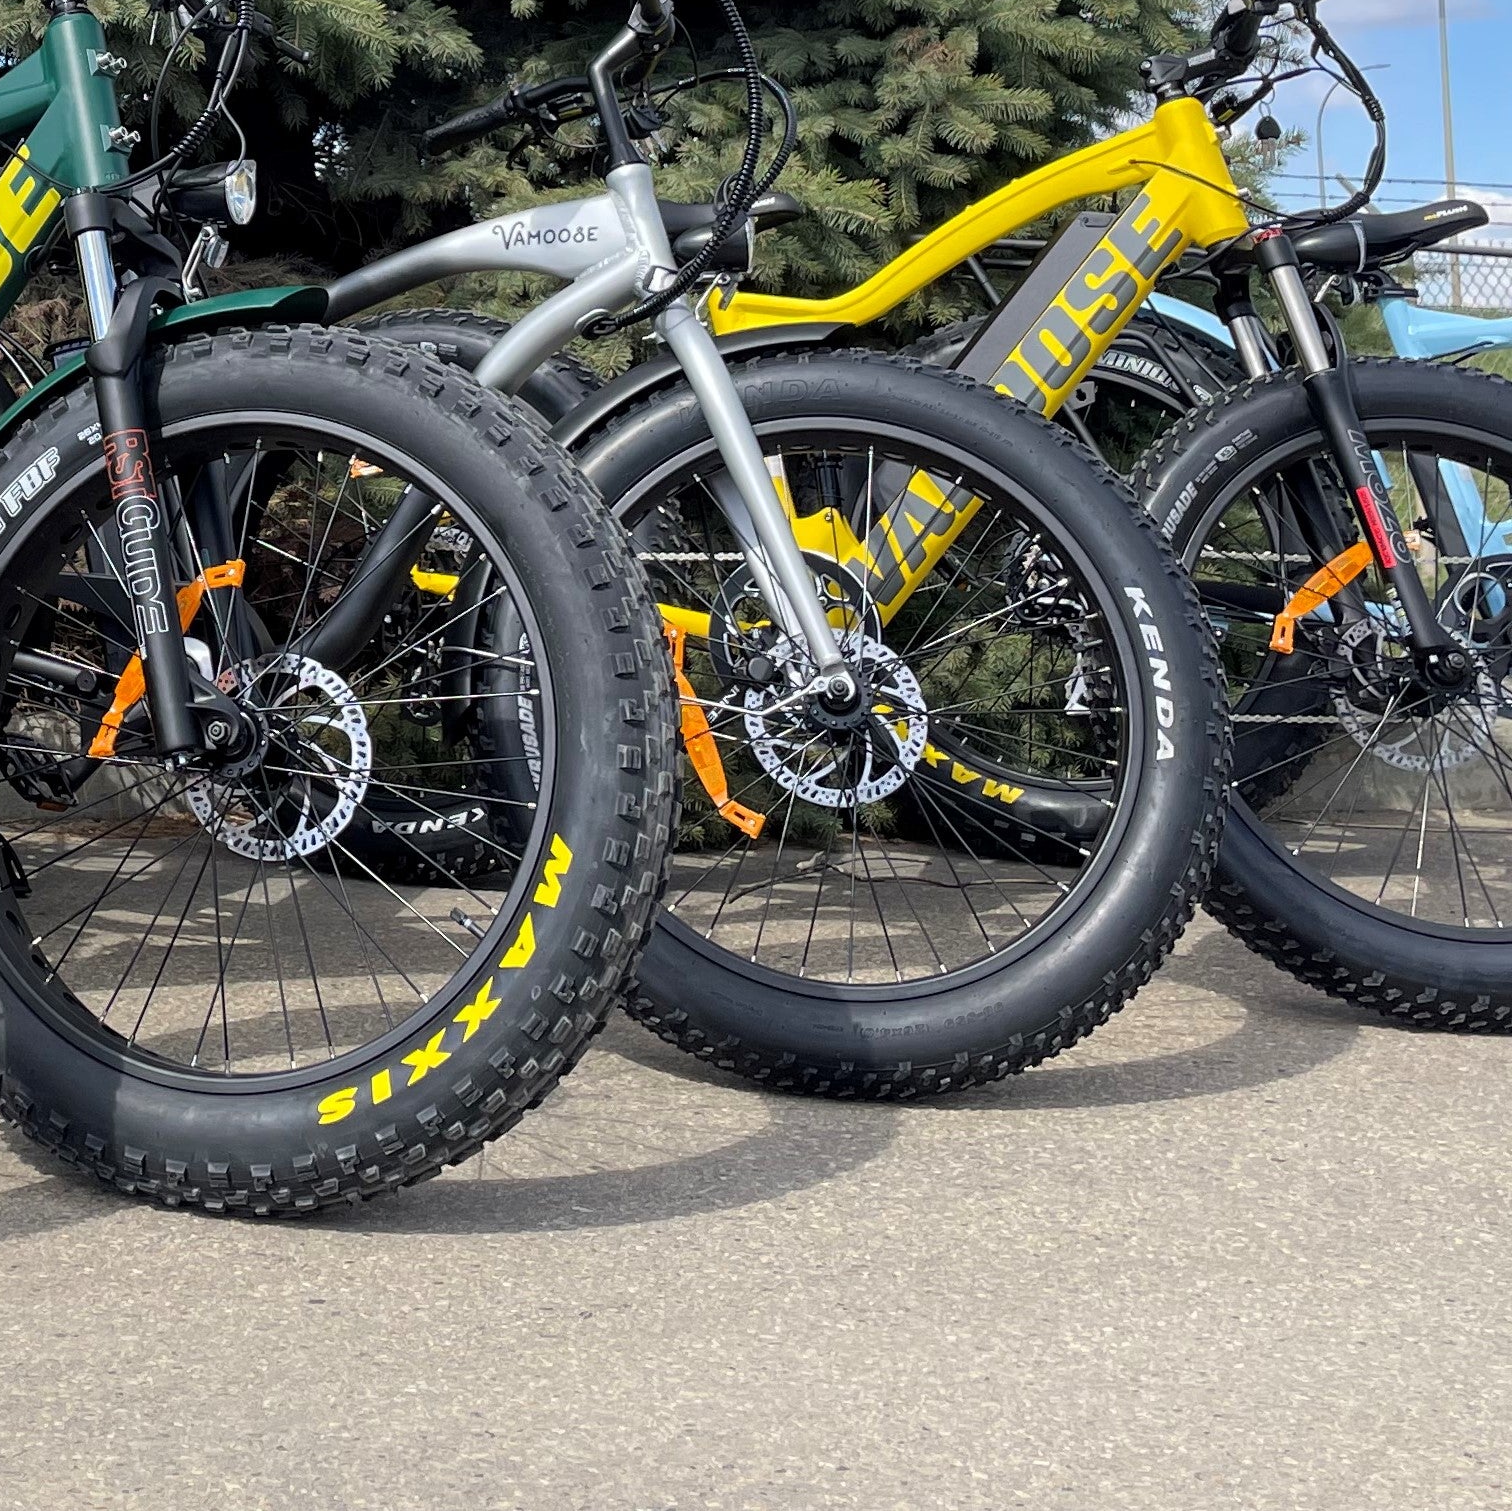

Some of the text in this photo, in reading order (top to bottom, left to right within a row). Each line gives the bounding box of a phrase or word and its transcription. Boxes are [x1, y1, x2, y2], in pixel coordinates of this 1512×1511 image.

[492, 221, 599, 250] VAMOOSE
[103, 429, 170, 660] RST GUIDE
[1123, 586, 1175, 761] KENDA
[317, 834, 574, 1125] MAXXIS
